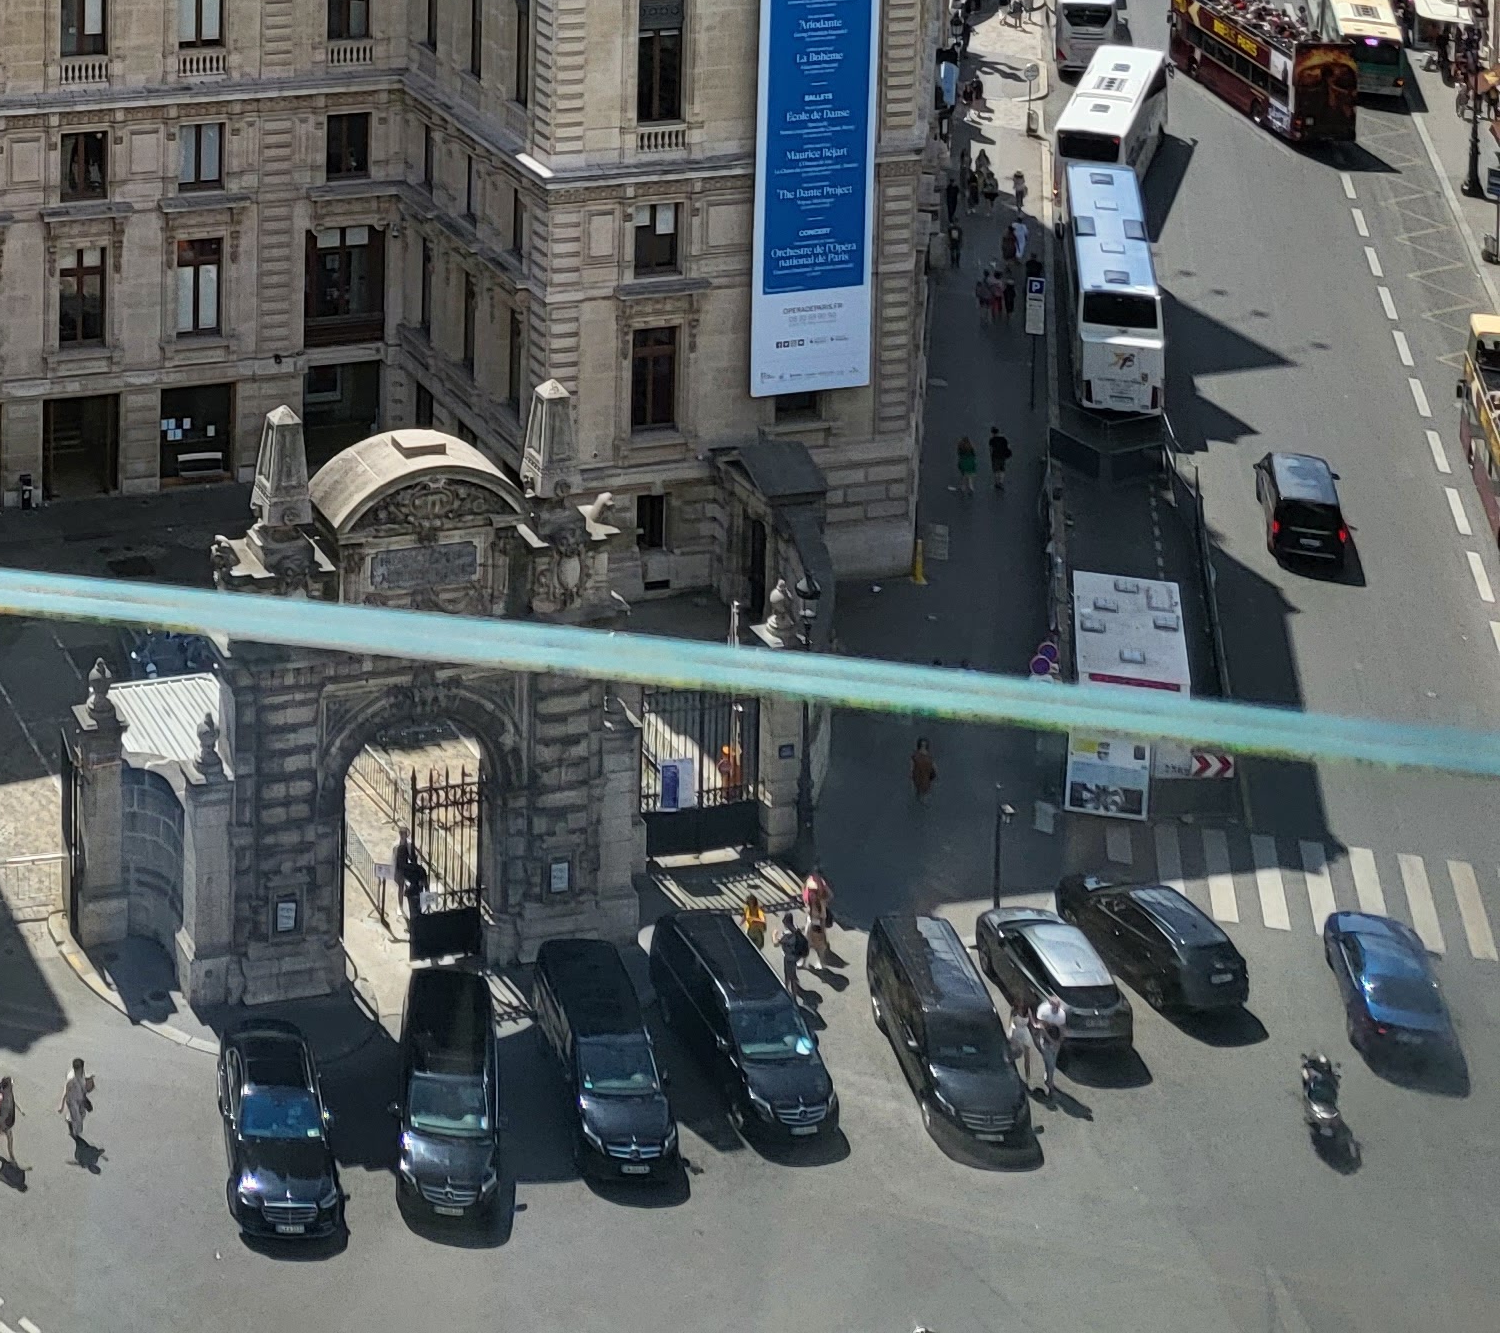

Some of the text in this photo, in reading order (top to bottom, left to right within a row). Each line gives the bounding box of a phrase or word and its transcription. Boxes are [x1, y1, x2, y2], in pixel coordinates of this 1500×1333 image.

[796, 53, 808, 63] La
[810, 110, 822, 120] de
[786, 149, 820, 160] Maurice
[823, 185, 853, 196] Project
[771, 246, 813, 258] Orchestre
[813, 244, 825, 254] de
[779, 252, 849, 267] national de Paris
[1031, 281, 1041, 293] P
